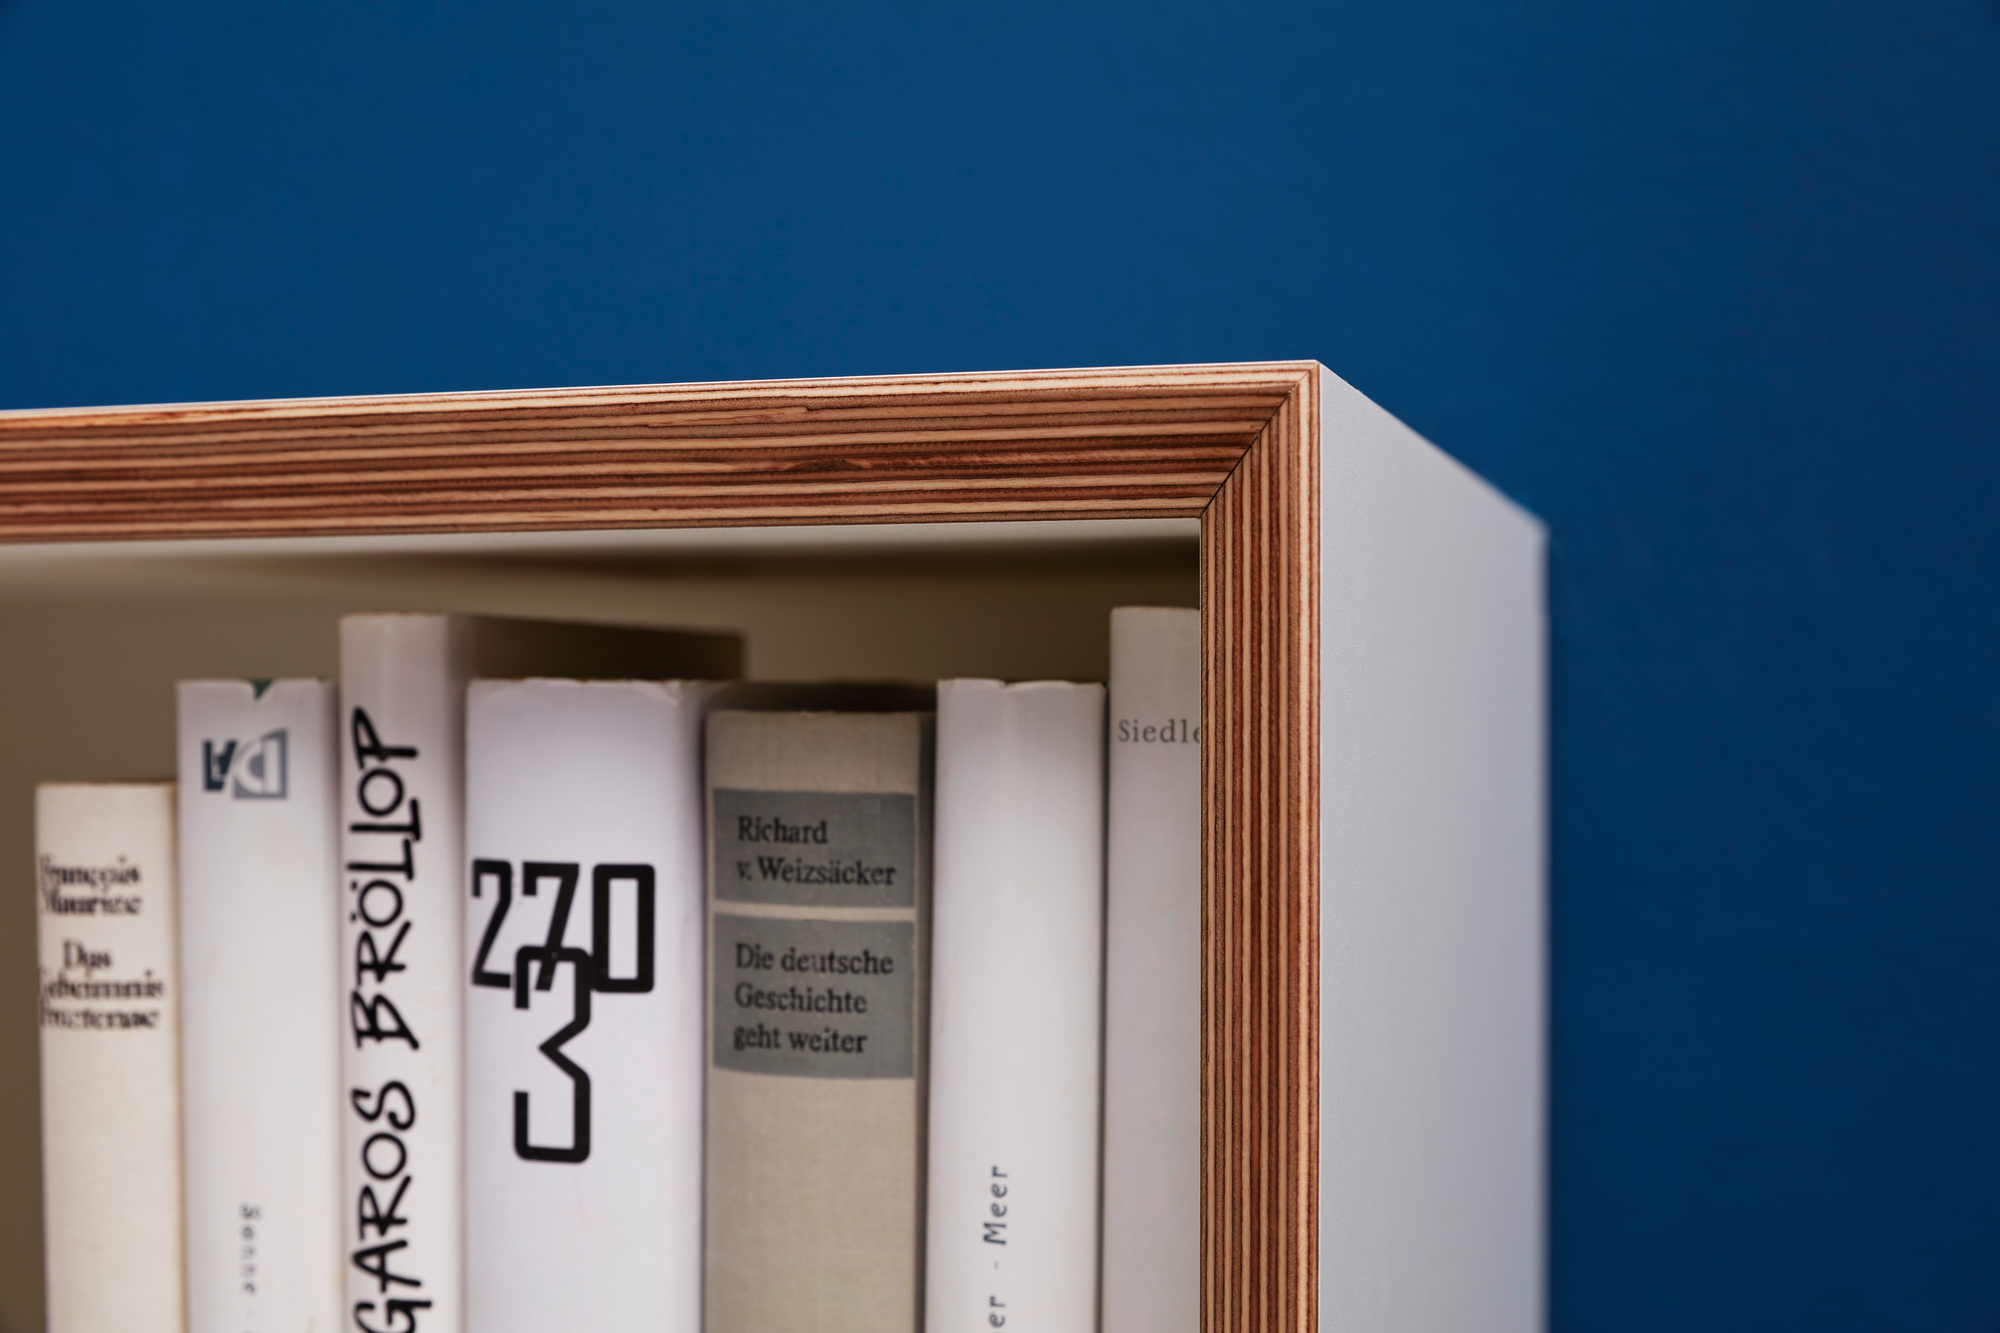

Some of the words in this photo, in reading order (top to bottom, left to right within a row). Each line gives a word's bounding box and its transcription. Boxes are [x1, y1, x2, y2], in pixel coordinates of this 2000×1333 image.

[738, 815, 828, 844] Richard
[347, 706, 421, 1048] BRÖLLOP
[737, 861, 752, 880] v.
[757, 855, 896, 885] Weizsäcker
[472, 858, 655, 993] 270
[735, 942, 774, 970] Die
[781, 947, 894, 975] deutsche
[735, 982, 868, 1013] Geschichte
[514, 944, 591, 1164] 3
[734, 1024, 781, 1051] geht
[788, 1027, 868, 1053] weiter
[983, 1165, 1008, 1246] Meer
